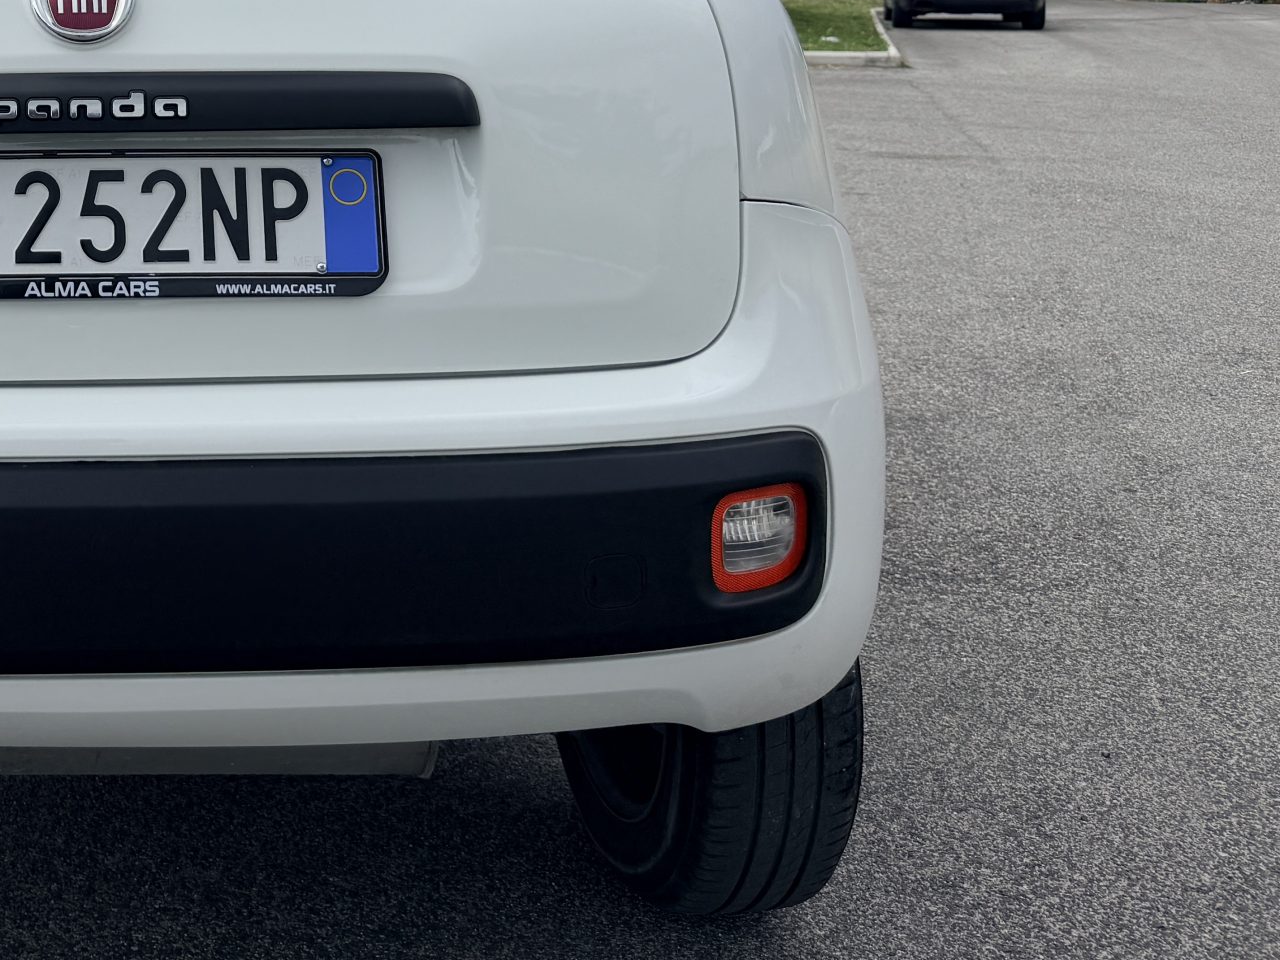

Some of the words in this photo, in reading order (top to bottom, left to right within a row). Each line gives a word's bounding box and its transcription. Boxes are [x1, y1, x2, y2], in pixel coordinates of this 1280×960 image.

[15, 167, 309, 264] 252NP
[24, 281, 92, 297] ALMA
[98, 281, 160, 297] CARS
[216, 284, 336, 295] WWW.ALMACARS.IT
